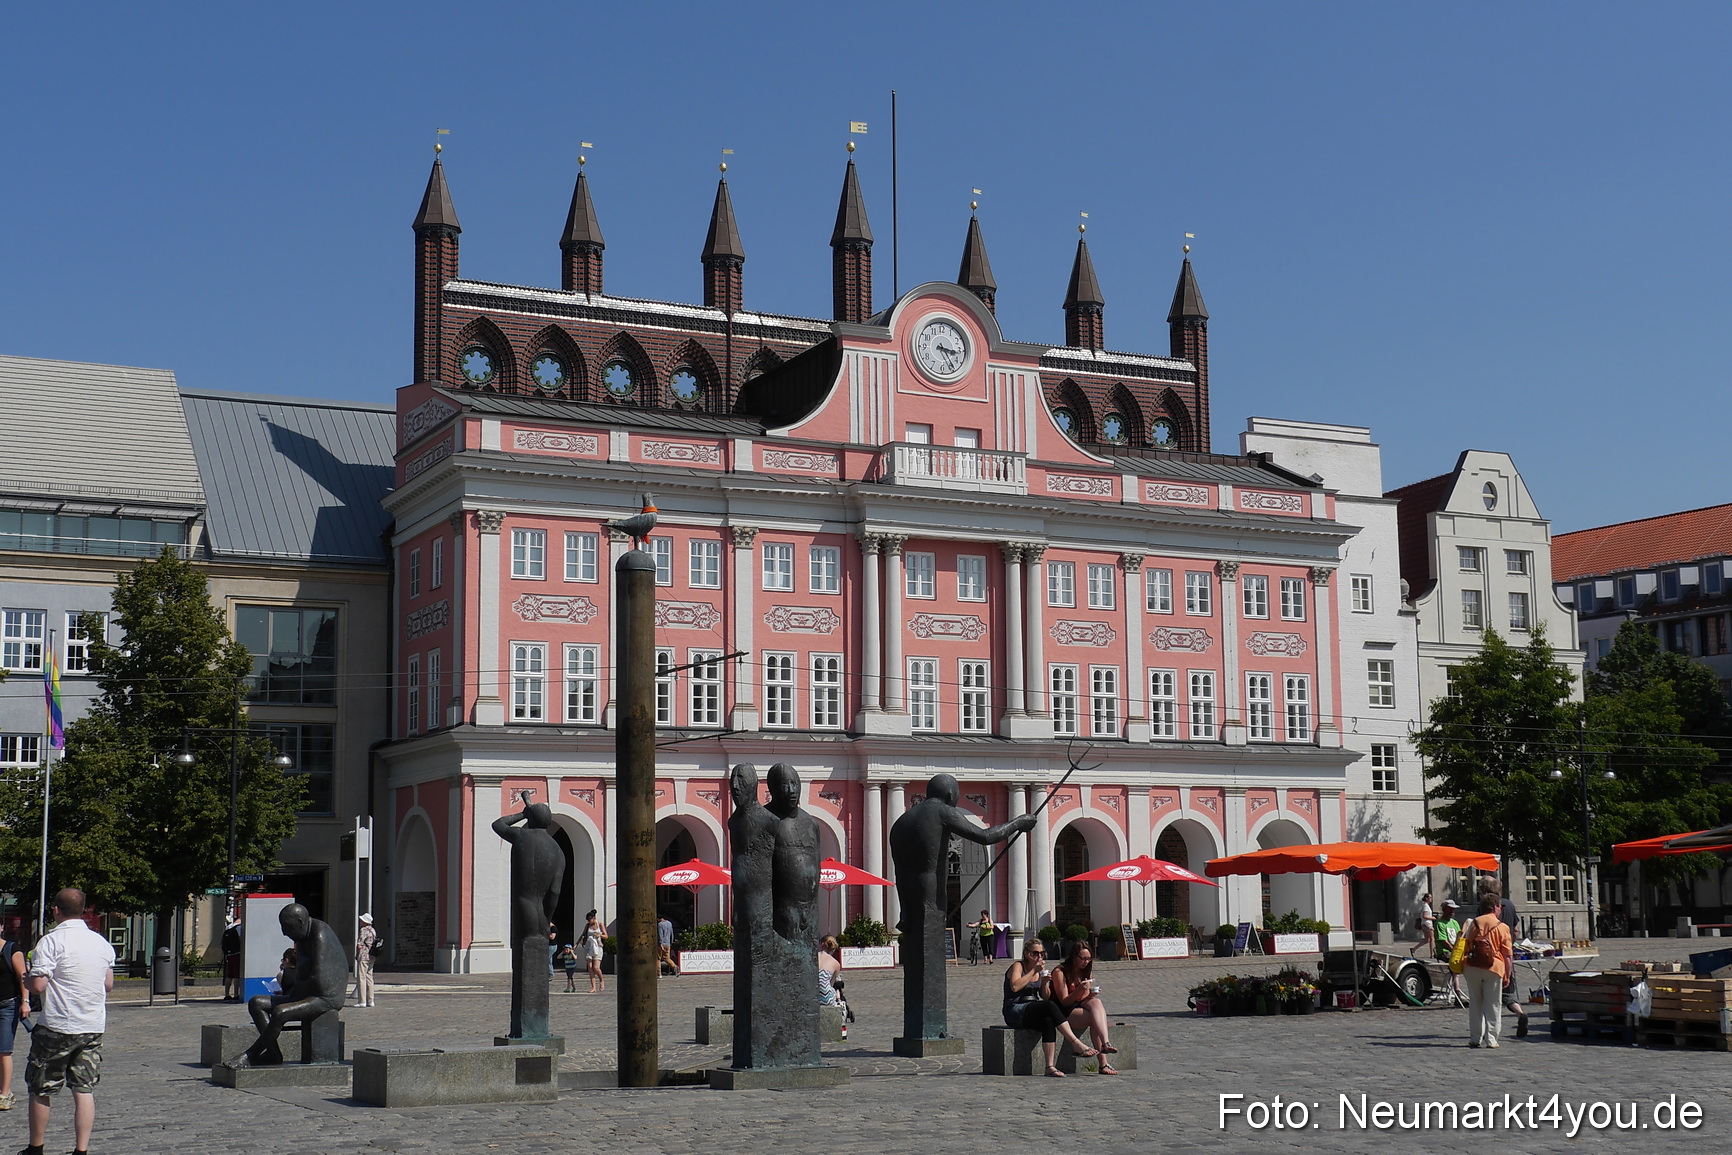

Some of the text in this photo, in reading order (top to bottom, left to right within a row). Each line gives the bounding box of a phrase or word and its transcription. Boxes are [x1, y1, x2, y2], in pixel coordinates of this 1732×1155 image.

[931, 327, 937, 335] 11
[938, 325, 946, 334] 12
[924, 333, 931, 341] 10
[954, 337, 959, 345] 2
[922, 343, 928, 351] 9
[924, 352, 930, 360] 8
